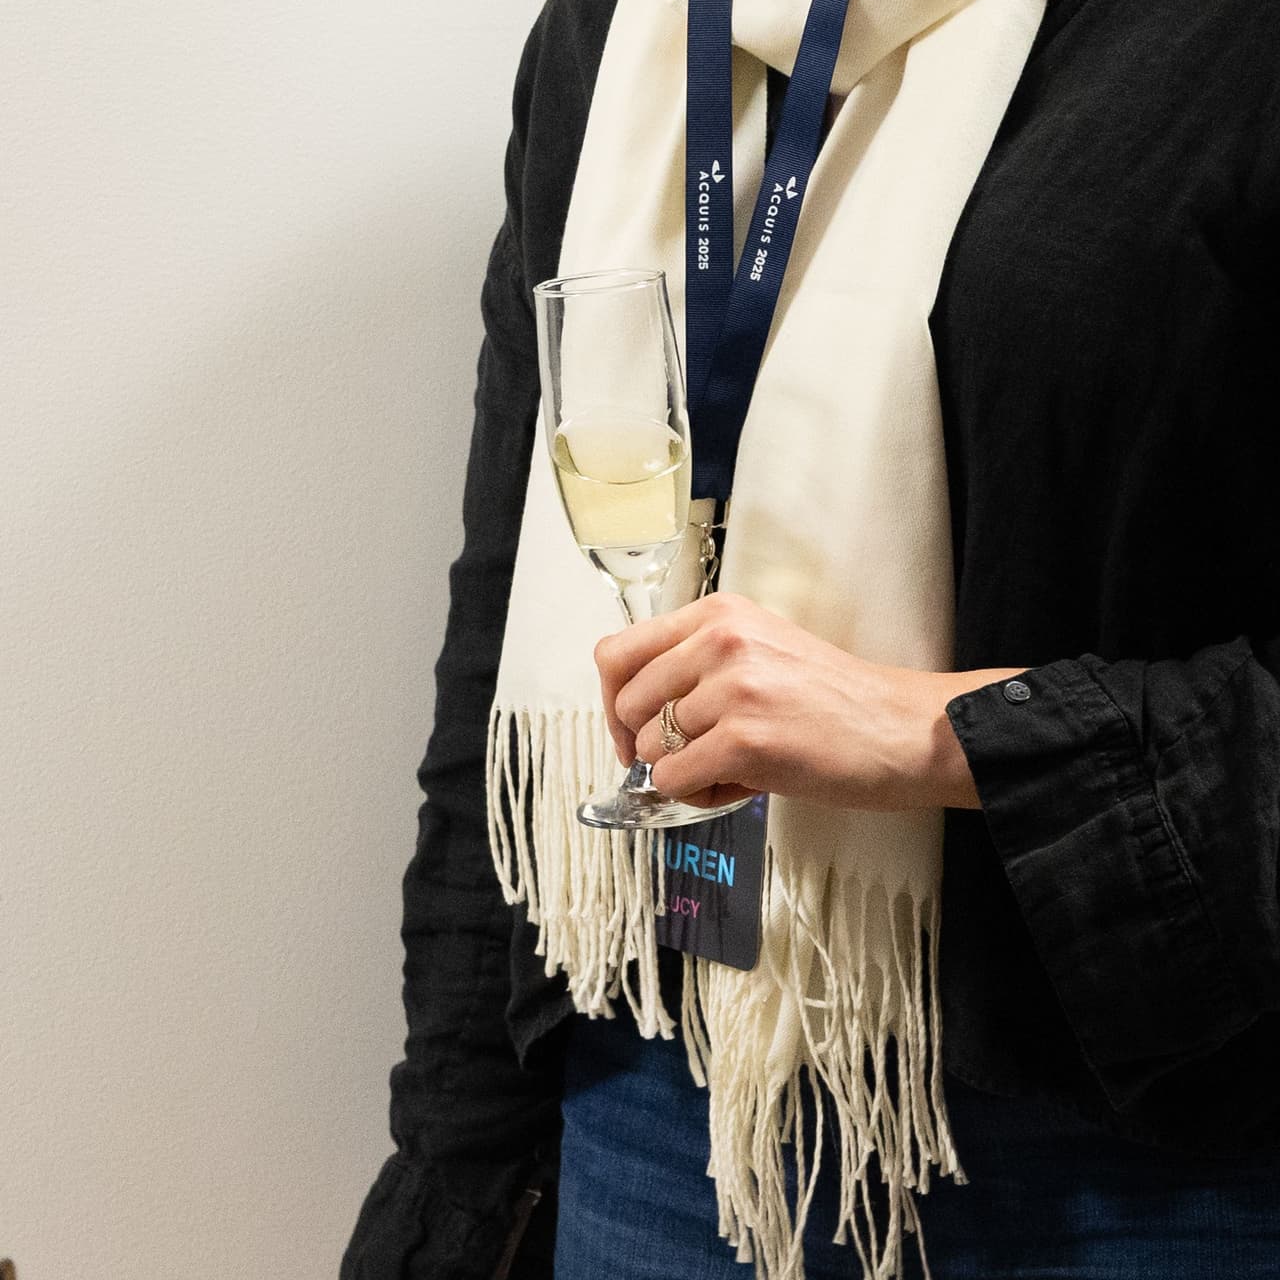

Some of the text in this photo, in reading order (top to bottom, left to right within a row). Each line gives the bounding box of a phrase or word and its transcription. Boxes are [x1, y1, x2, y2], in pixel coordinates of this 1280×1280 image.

[698, 170, 710, 270] ACQUIS 2025
[749, 182, 784, 281] ACQUIS 2025
[653, 836, 735, 888] UREN
